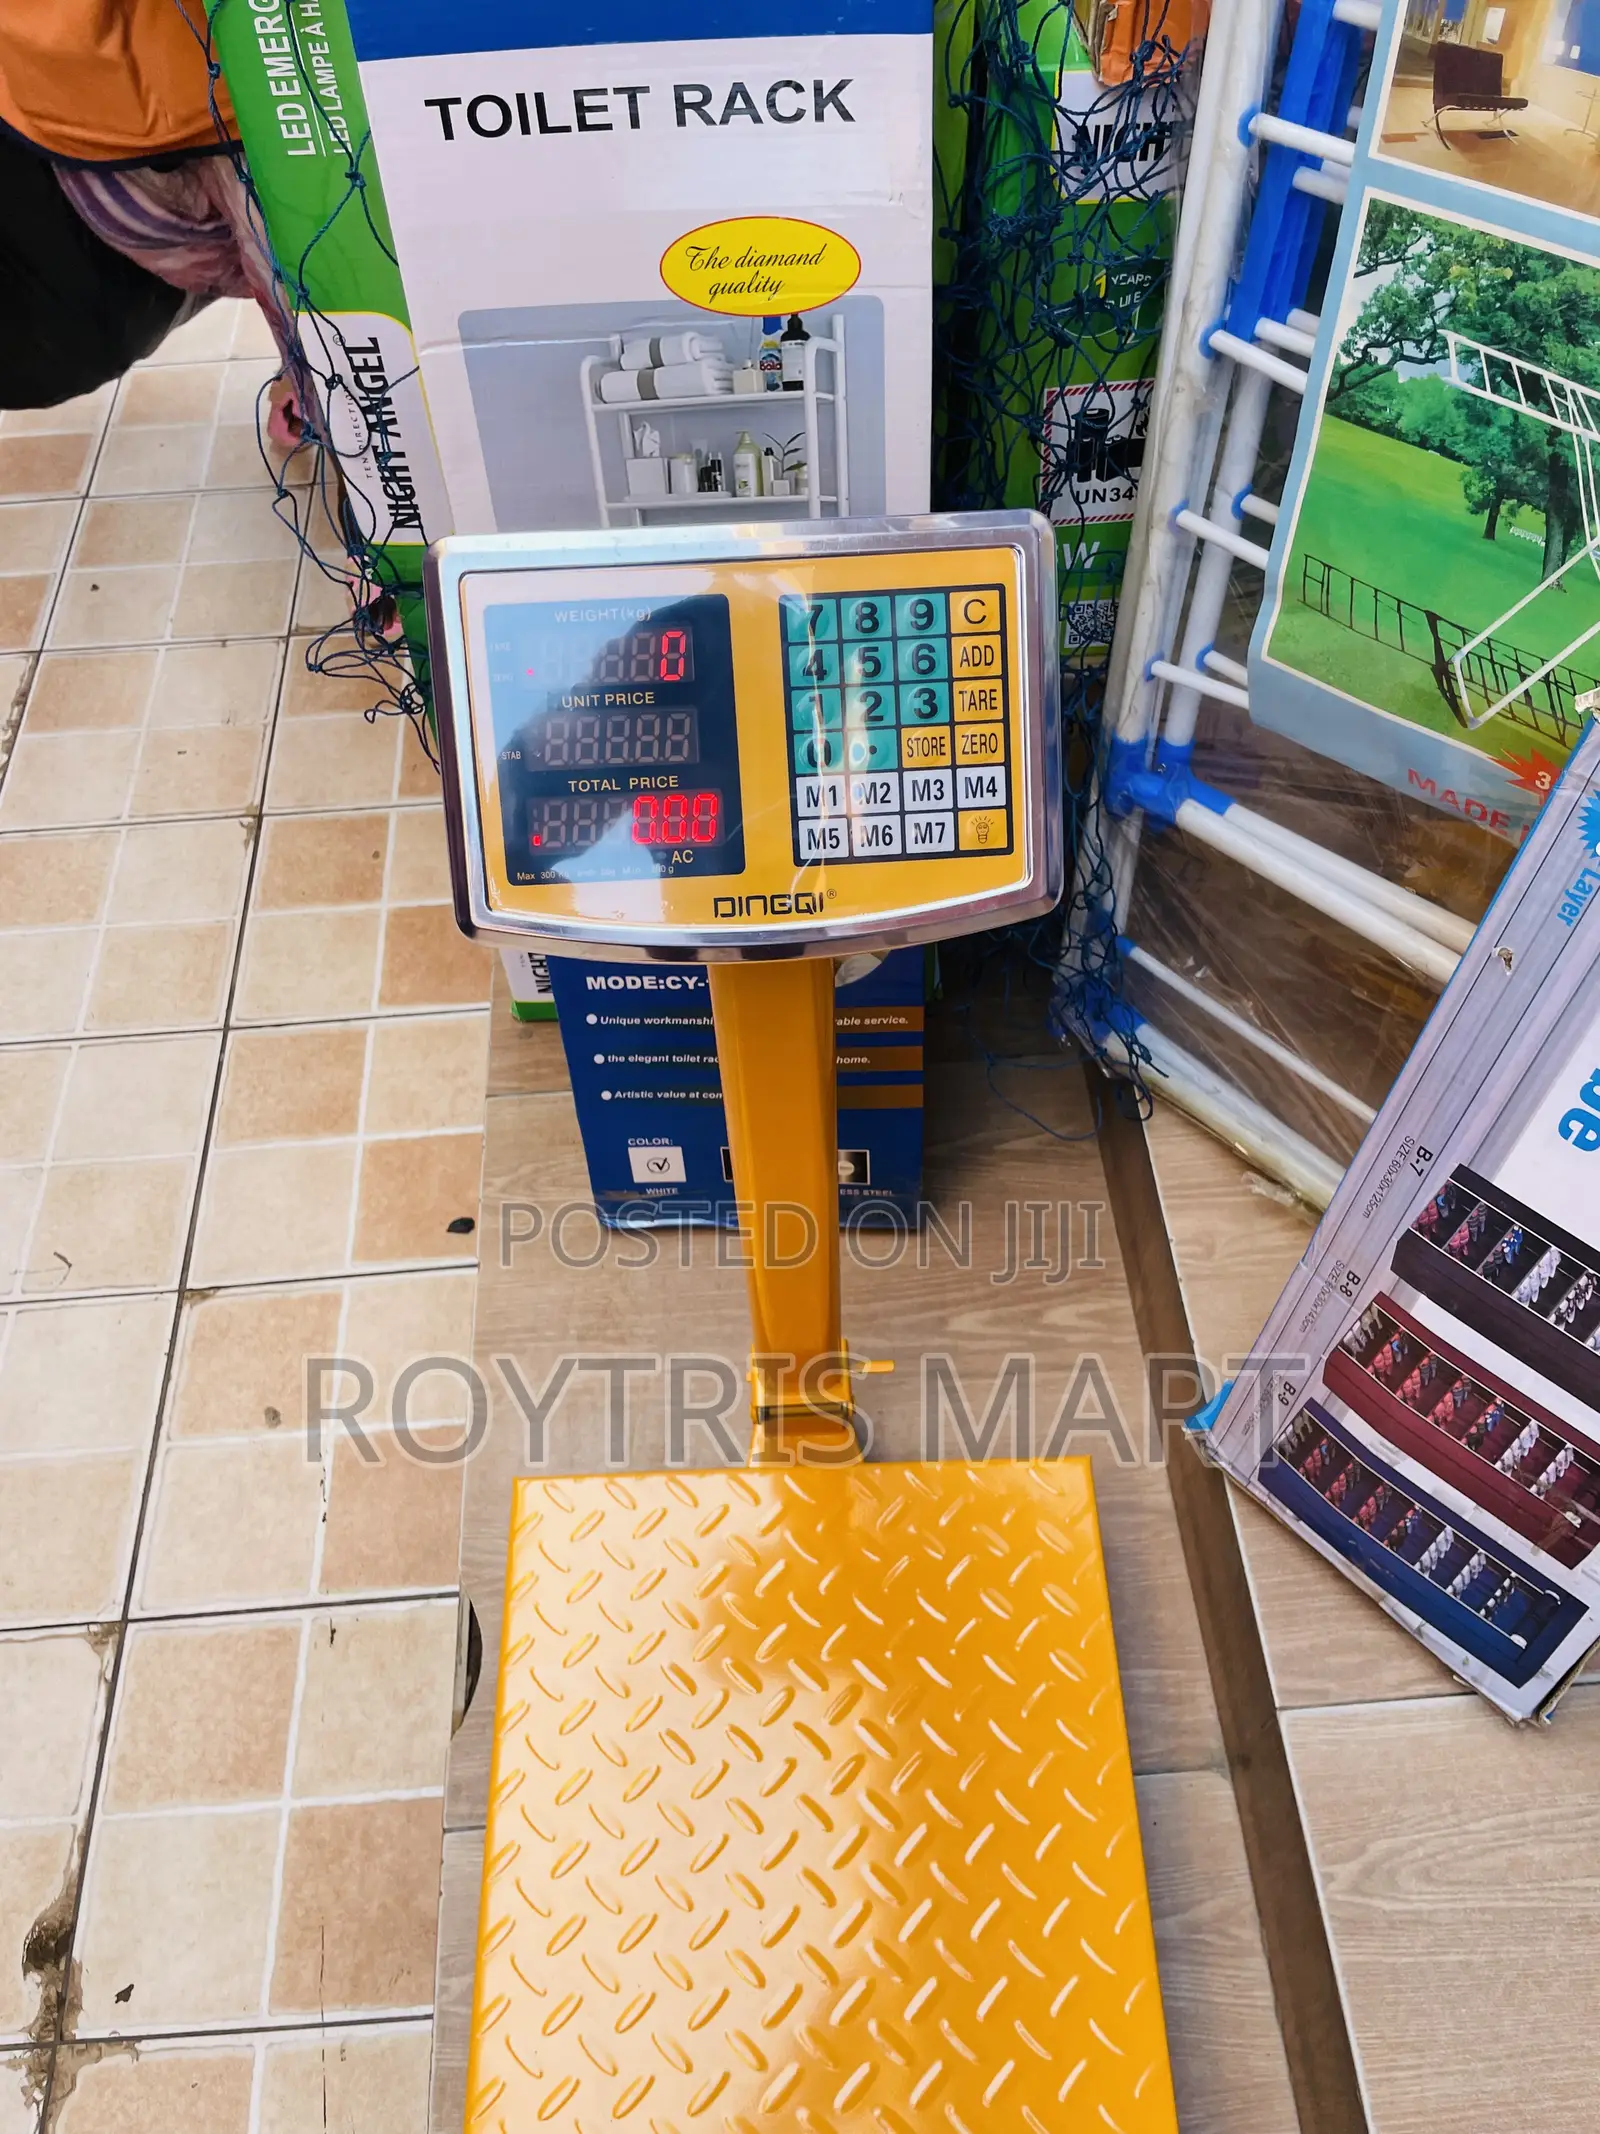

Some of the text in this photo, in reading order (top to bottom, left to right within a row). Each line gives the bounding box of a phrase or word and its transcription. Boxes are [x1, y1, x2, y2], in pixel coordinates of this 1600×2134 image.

[300, 22, 326, 37] À
[308, 42, 343, 110] LAMPE
[424, 79, 856, 141] TOILET RACK
[276, 103, 316, 155] LED
[327, 116, 352, 153] LED
[1075, 121, 1174, 165] NIGH
[685, 245, 732, 271] The
[708, 270, 785, 303] quality
[346, 337, 422, 528] NIGHT ANGEL
[361, 457, 373, 478] TEN
[1075, 487, 1137, 504] UN34
[1056, 541, 1100, 570] W
[554, 606, 653, 623] WEIGHT(kg)
[855, 602, 880, 634] 8
[909, 598, 934, 631] 9
[963, 598, 987, 624] C
[660, 630, 686, 681] 0
[803, 649, 827, 681] 4
[858, 646, 882, 678] 5
[911, 643, 936, 675] 6
[960, 645, 994, 668] ADD
[561, 692, 655, 708] UNIT PRICE
[859, 690, 884, 722] 2
[913, 687, 938, 719] 3
[958, 689, 998, 712] TARE
[501, 751, 521, 760] STAB
[806, 738, 832, 768] 0
[907, 736, 946, 758] STORE
[961, 733, 998, 755] ZERO
[568, 776, 679, 793] TOTAL PRICE
[911, 779, 944, 802] M3
[964, 776, 998, 799] M4
[1535, 771, 1551, 790] 3
[806, 785, 838, 808] M1
[859, 782, 892, 806] M2
[1408, 768, 1511, 837] MADE
[807, 827, 840, 850] M5
[860, 824, 893, 847] M6
[914, 822, 946, 845] M7
[671, 850, 694, 864] AC
[517, 871, 535, 880] Max
[541, 870, 555, 879] 300
[713, 892, 824, 918] DINGQI
[1557, 868, 1600, 927] Layer
[586, 975, 708, 990] MODE:CY-
[600, 1015, 908, 1027] Unique workmanshi able service.
[607, 1054, 625, 1063] the
[628, 1054, 669, 1064] elegant
[672, 1054, 700, 1063] toilet
[836, 1055, 870, 1064] home.
[614, 1090, 653, 1099] Artistic
[656, 1090, 686, 1099] value
[689, 1090, 699, 1099] at
[628, 1138, 673, 1146] COLOR:
[1409, 1145, 1433, 1177] B-7
[645, 1187, 678, 1195] WHITE
[863, 1189, 894, 1197] STEEL
[1340, 1270, 1361, 1297] B-8
[1278, 1381, 1296, 1406] B-9
